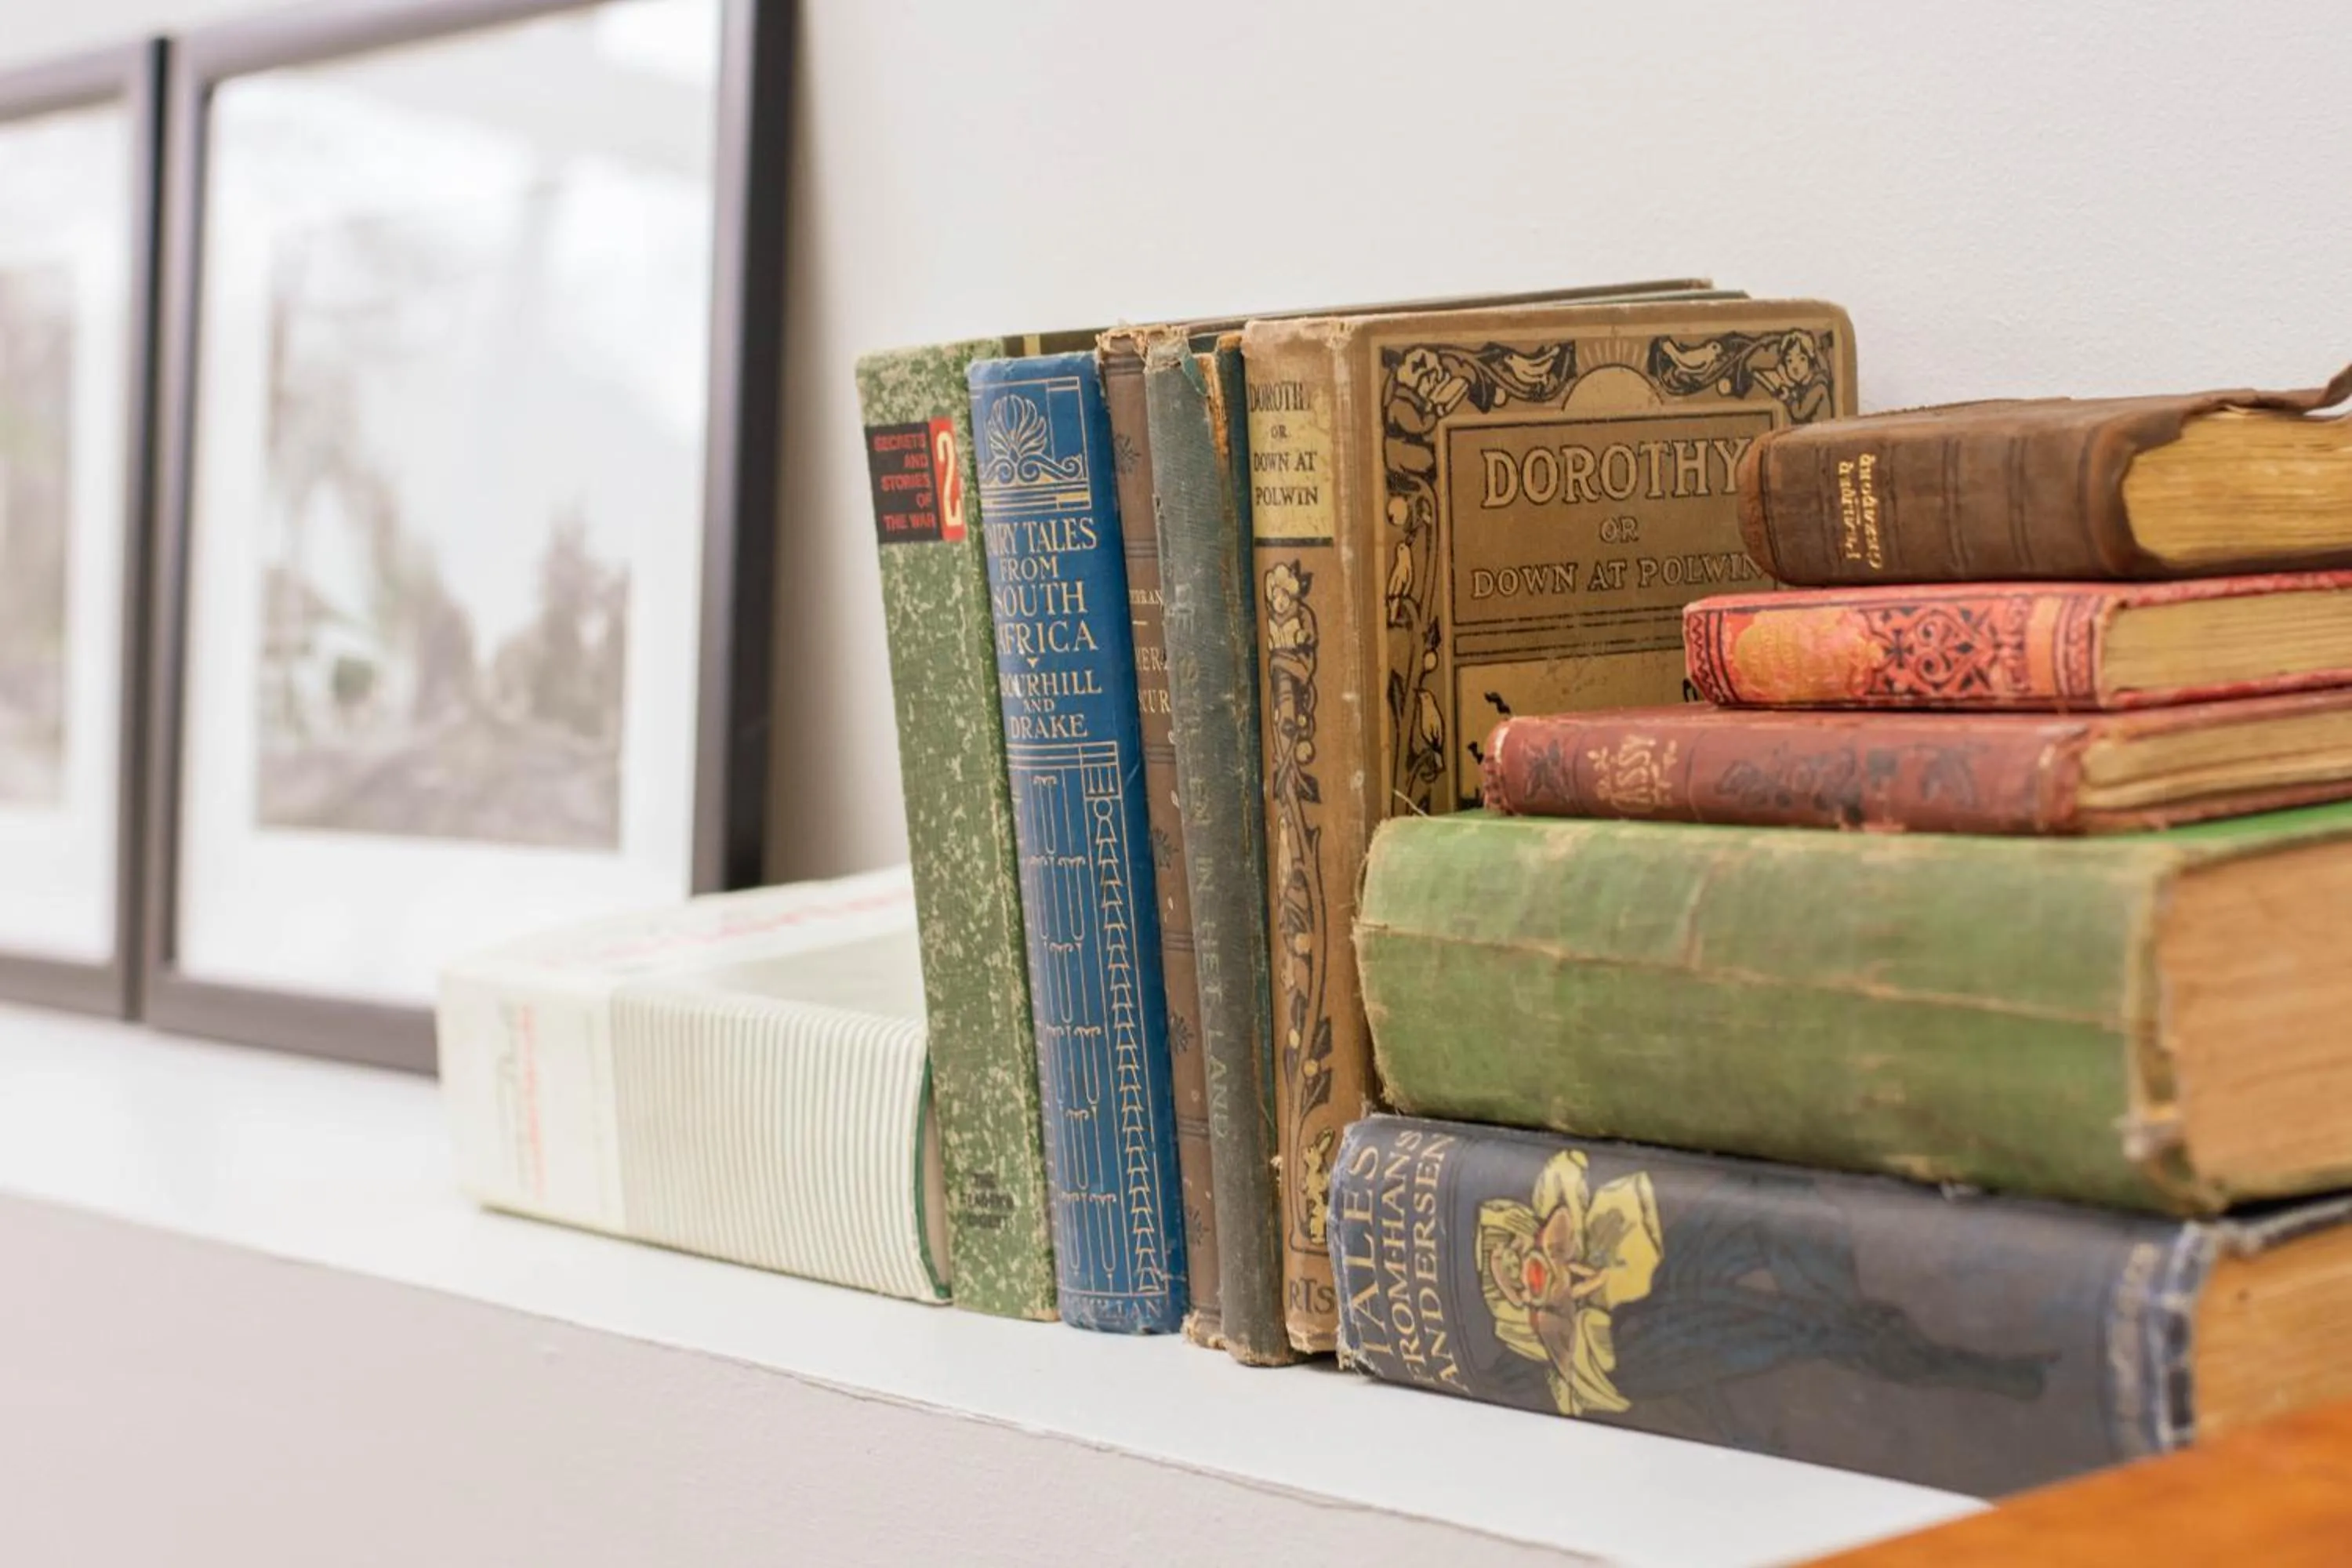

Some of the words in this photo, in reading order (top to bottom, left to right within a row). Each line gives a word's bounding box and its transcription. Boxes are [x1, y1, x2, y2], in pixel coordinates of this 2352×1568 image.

[1271, 424, 1287, 438] OR
[904, 453, 928, 468] AND
[1254, 451, 1290, 471] DOWN
[1294, 450, 1318, 470] AT
[1480, 437, 1751, 509] DOROTHY
[880, 473, 931, 491] STORIES
[937, 431, 963, 526] 2
[916, 492, 932, 508] OF
[1256, 486, 1318, 506] POLWIN
[883, 514, 908, 531] THE
[909, 513, 936, 528] WAR
[1599, 516, 1639, 543] OR
[1023, 517, 1098, 554] TALES
[1000, 555, 1059, 582] FROM
[1471, 562, 1578, 599] DOWN
[1588, 560, 1628, 591] AT
[1024, 698, 1054, 714] AND
[1010, 713, 1088, 739] DRAKE
[1207, 1029, 1229, 1138] LAND
[1344, 1145, 1394, 1356] TALES
[1414, 1132, 1471, 1394] ANDERSEN
